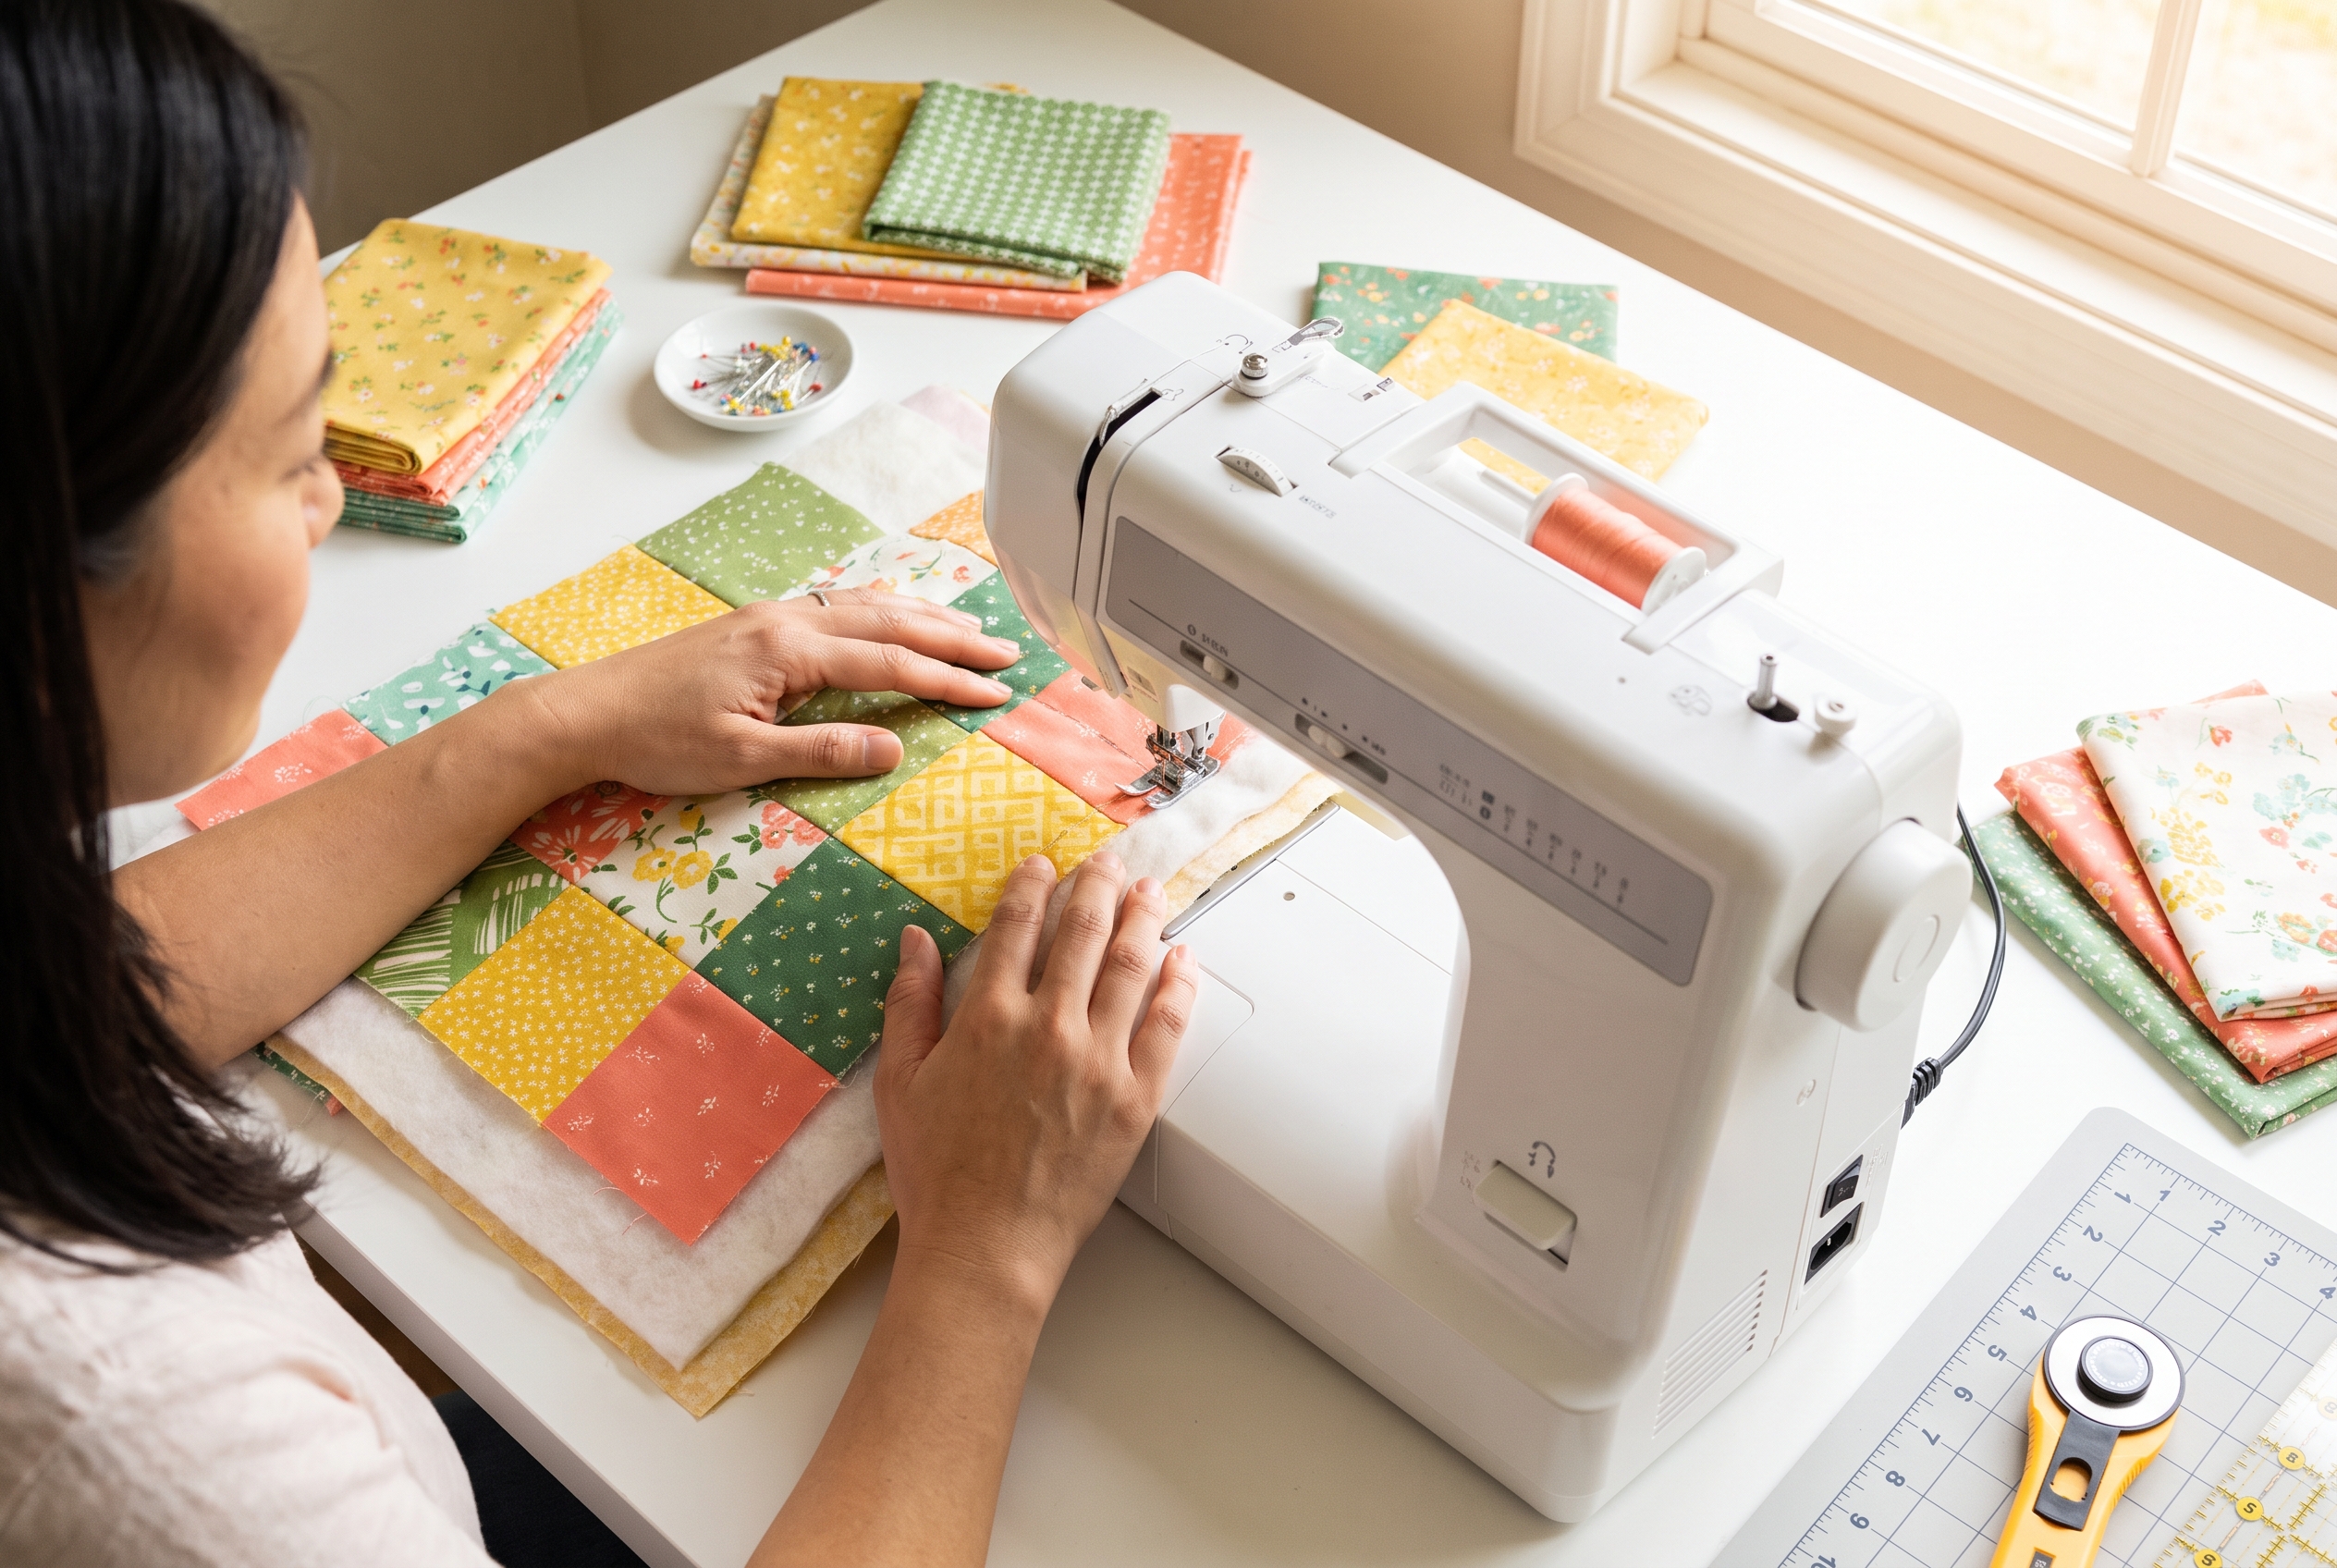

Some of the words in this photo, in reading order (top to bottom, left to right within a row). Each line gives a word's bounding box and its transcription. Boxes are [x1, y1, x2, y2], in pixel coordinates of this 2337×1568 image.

[2113, 1191, 2132, 1205] 1
[2082, 1224, 2103, 1243] 2
[2159, 1190, 2172, 1202] 1
[2207, 1219, 2227, 1237] 2
[2263, 1252, 2281, 1267] 3
[2319, 1286, 2337, 1300] 4
[2052, 1266, 2073, 1282] 3
[2019, 1305, 2037, 1321] 4
[1987, 1344, 2008, 1362] 5
[1953, 1386, 1974, 1403] 6
[1921, 1428, 1941, 1446] 7
[1885, 1470, 1906, 1488] 8
[1849, 1513, 1870, 1529] 9
